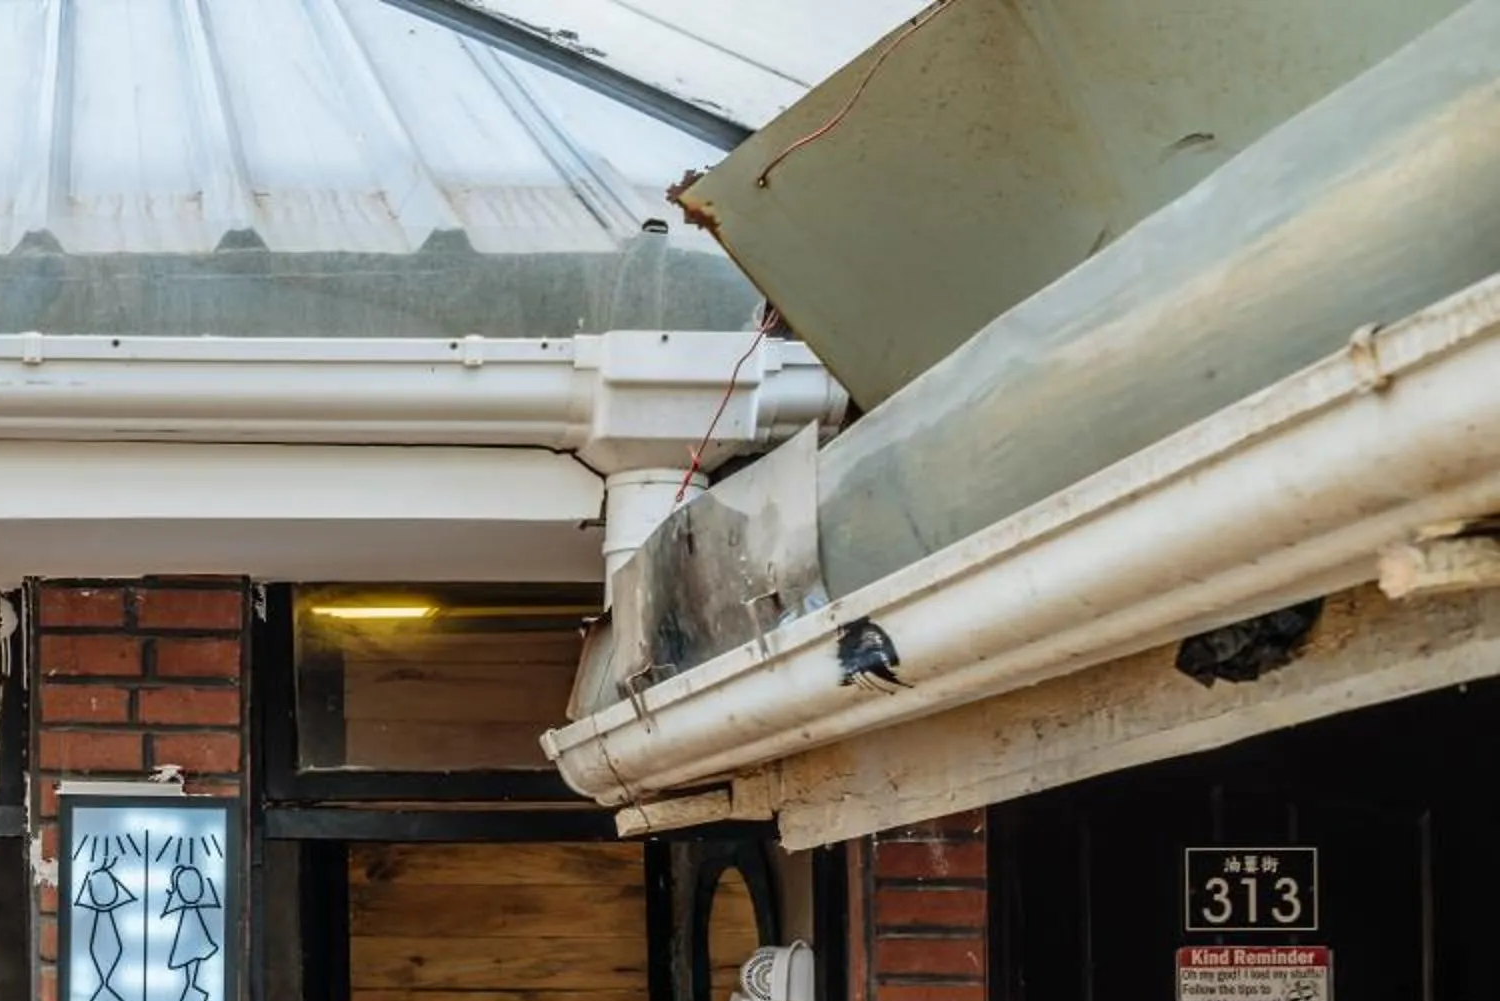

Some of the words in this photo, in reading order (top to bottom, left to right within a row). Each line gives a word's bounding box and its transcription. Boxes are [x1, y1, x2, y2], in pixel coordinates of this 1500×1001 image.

[1202, 877, 1301, 923] 313
[1191, 949, 1229, 965] Kind
[1234, 949, 1315, 965] Reminder
[1182, 984, 1216, 995] Follow
[1219, 984, 1236, 995] the
[1238, 984, 1258, 997] tips
[1260, 985, 1271, 995] to
